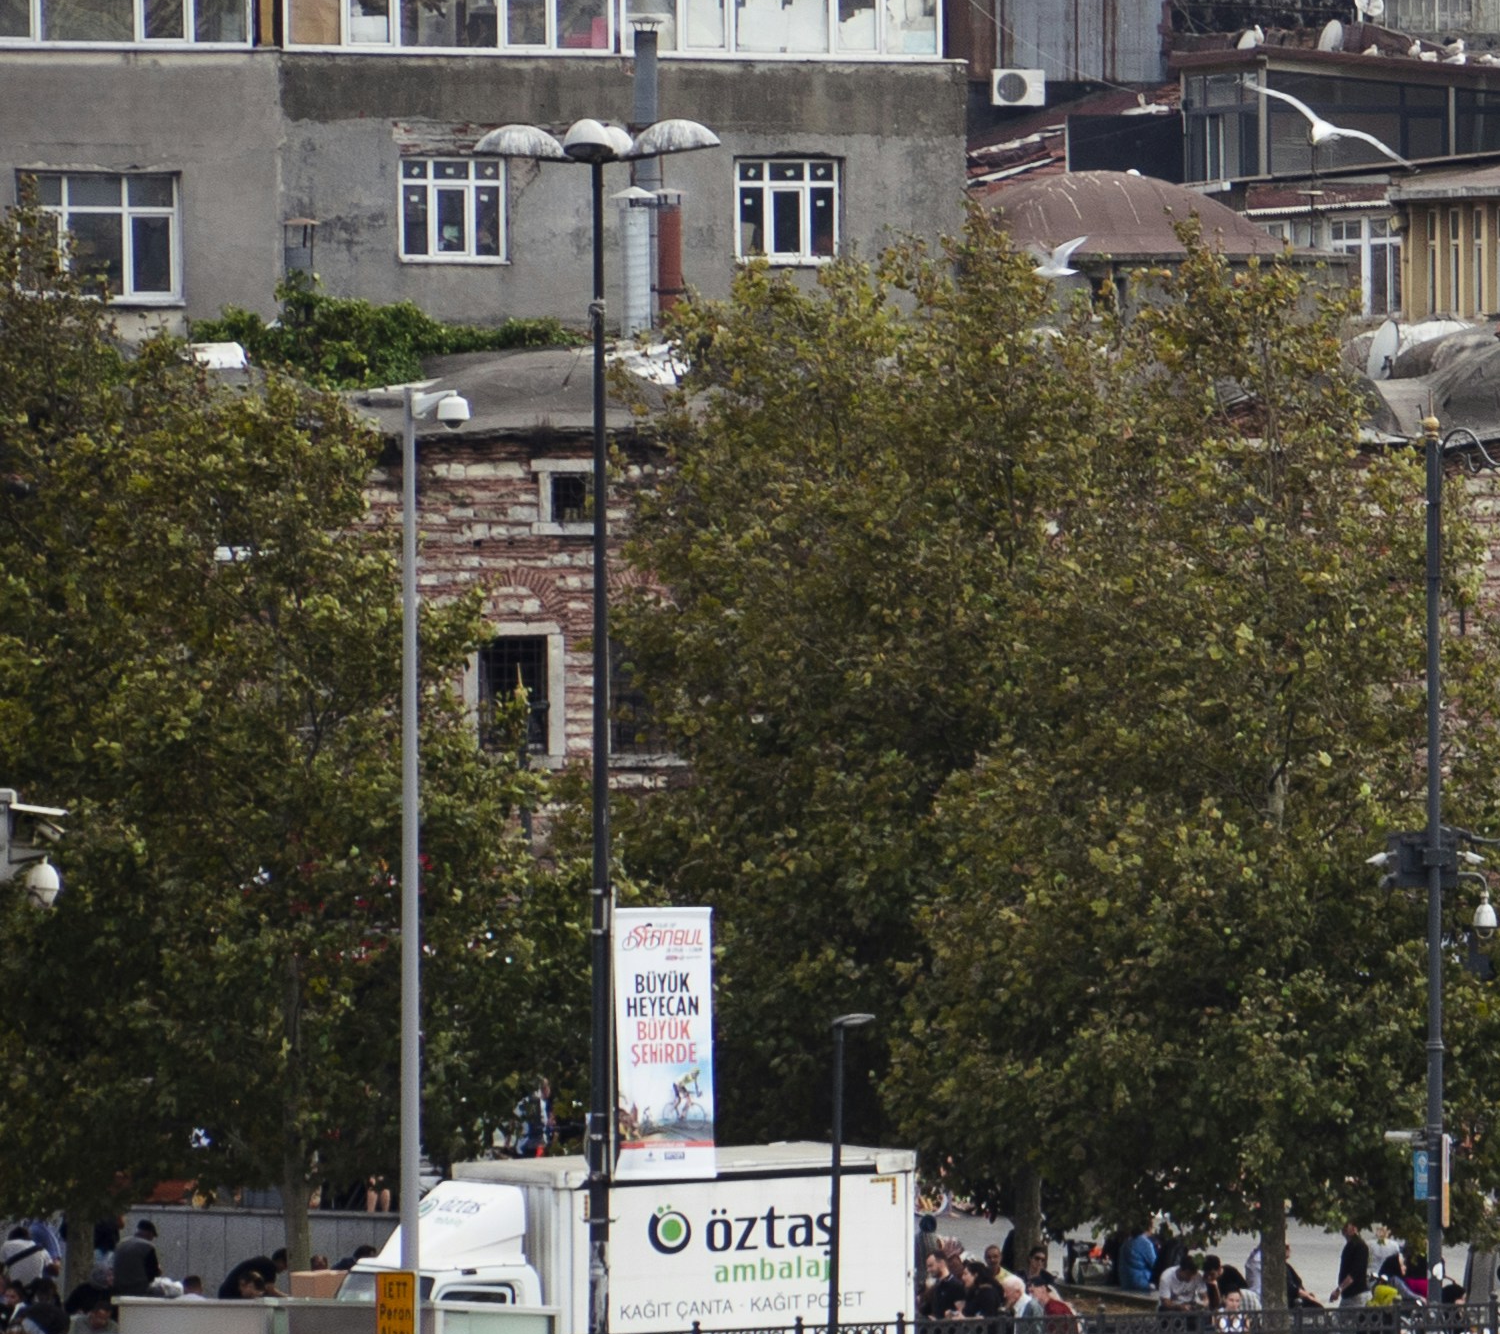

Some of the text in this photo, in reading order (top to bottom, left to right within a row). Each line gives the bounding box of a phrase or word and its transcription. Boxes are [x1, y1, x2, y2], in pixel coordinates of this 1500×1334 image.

[635, 970, 690, 994] BÜYÜK
[627, 995, 699, 1018] HEYECAN
[637, 1018, 691, 1042] BÜYÜK
[715, 1255, 832, 1285] ambalaj
[620, 1299, 671, 1321] KAĞIT
[676, 1297, 734, 1321] ÇANTA
[750, 1292, 802, 1314] KAĞIT
